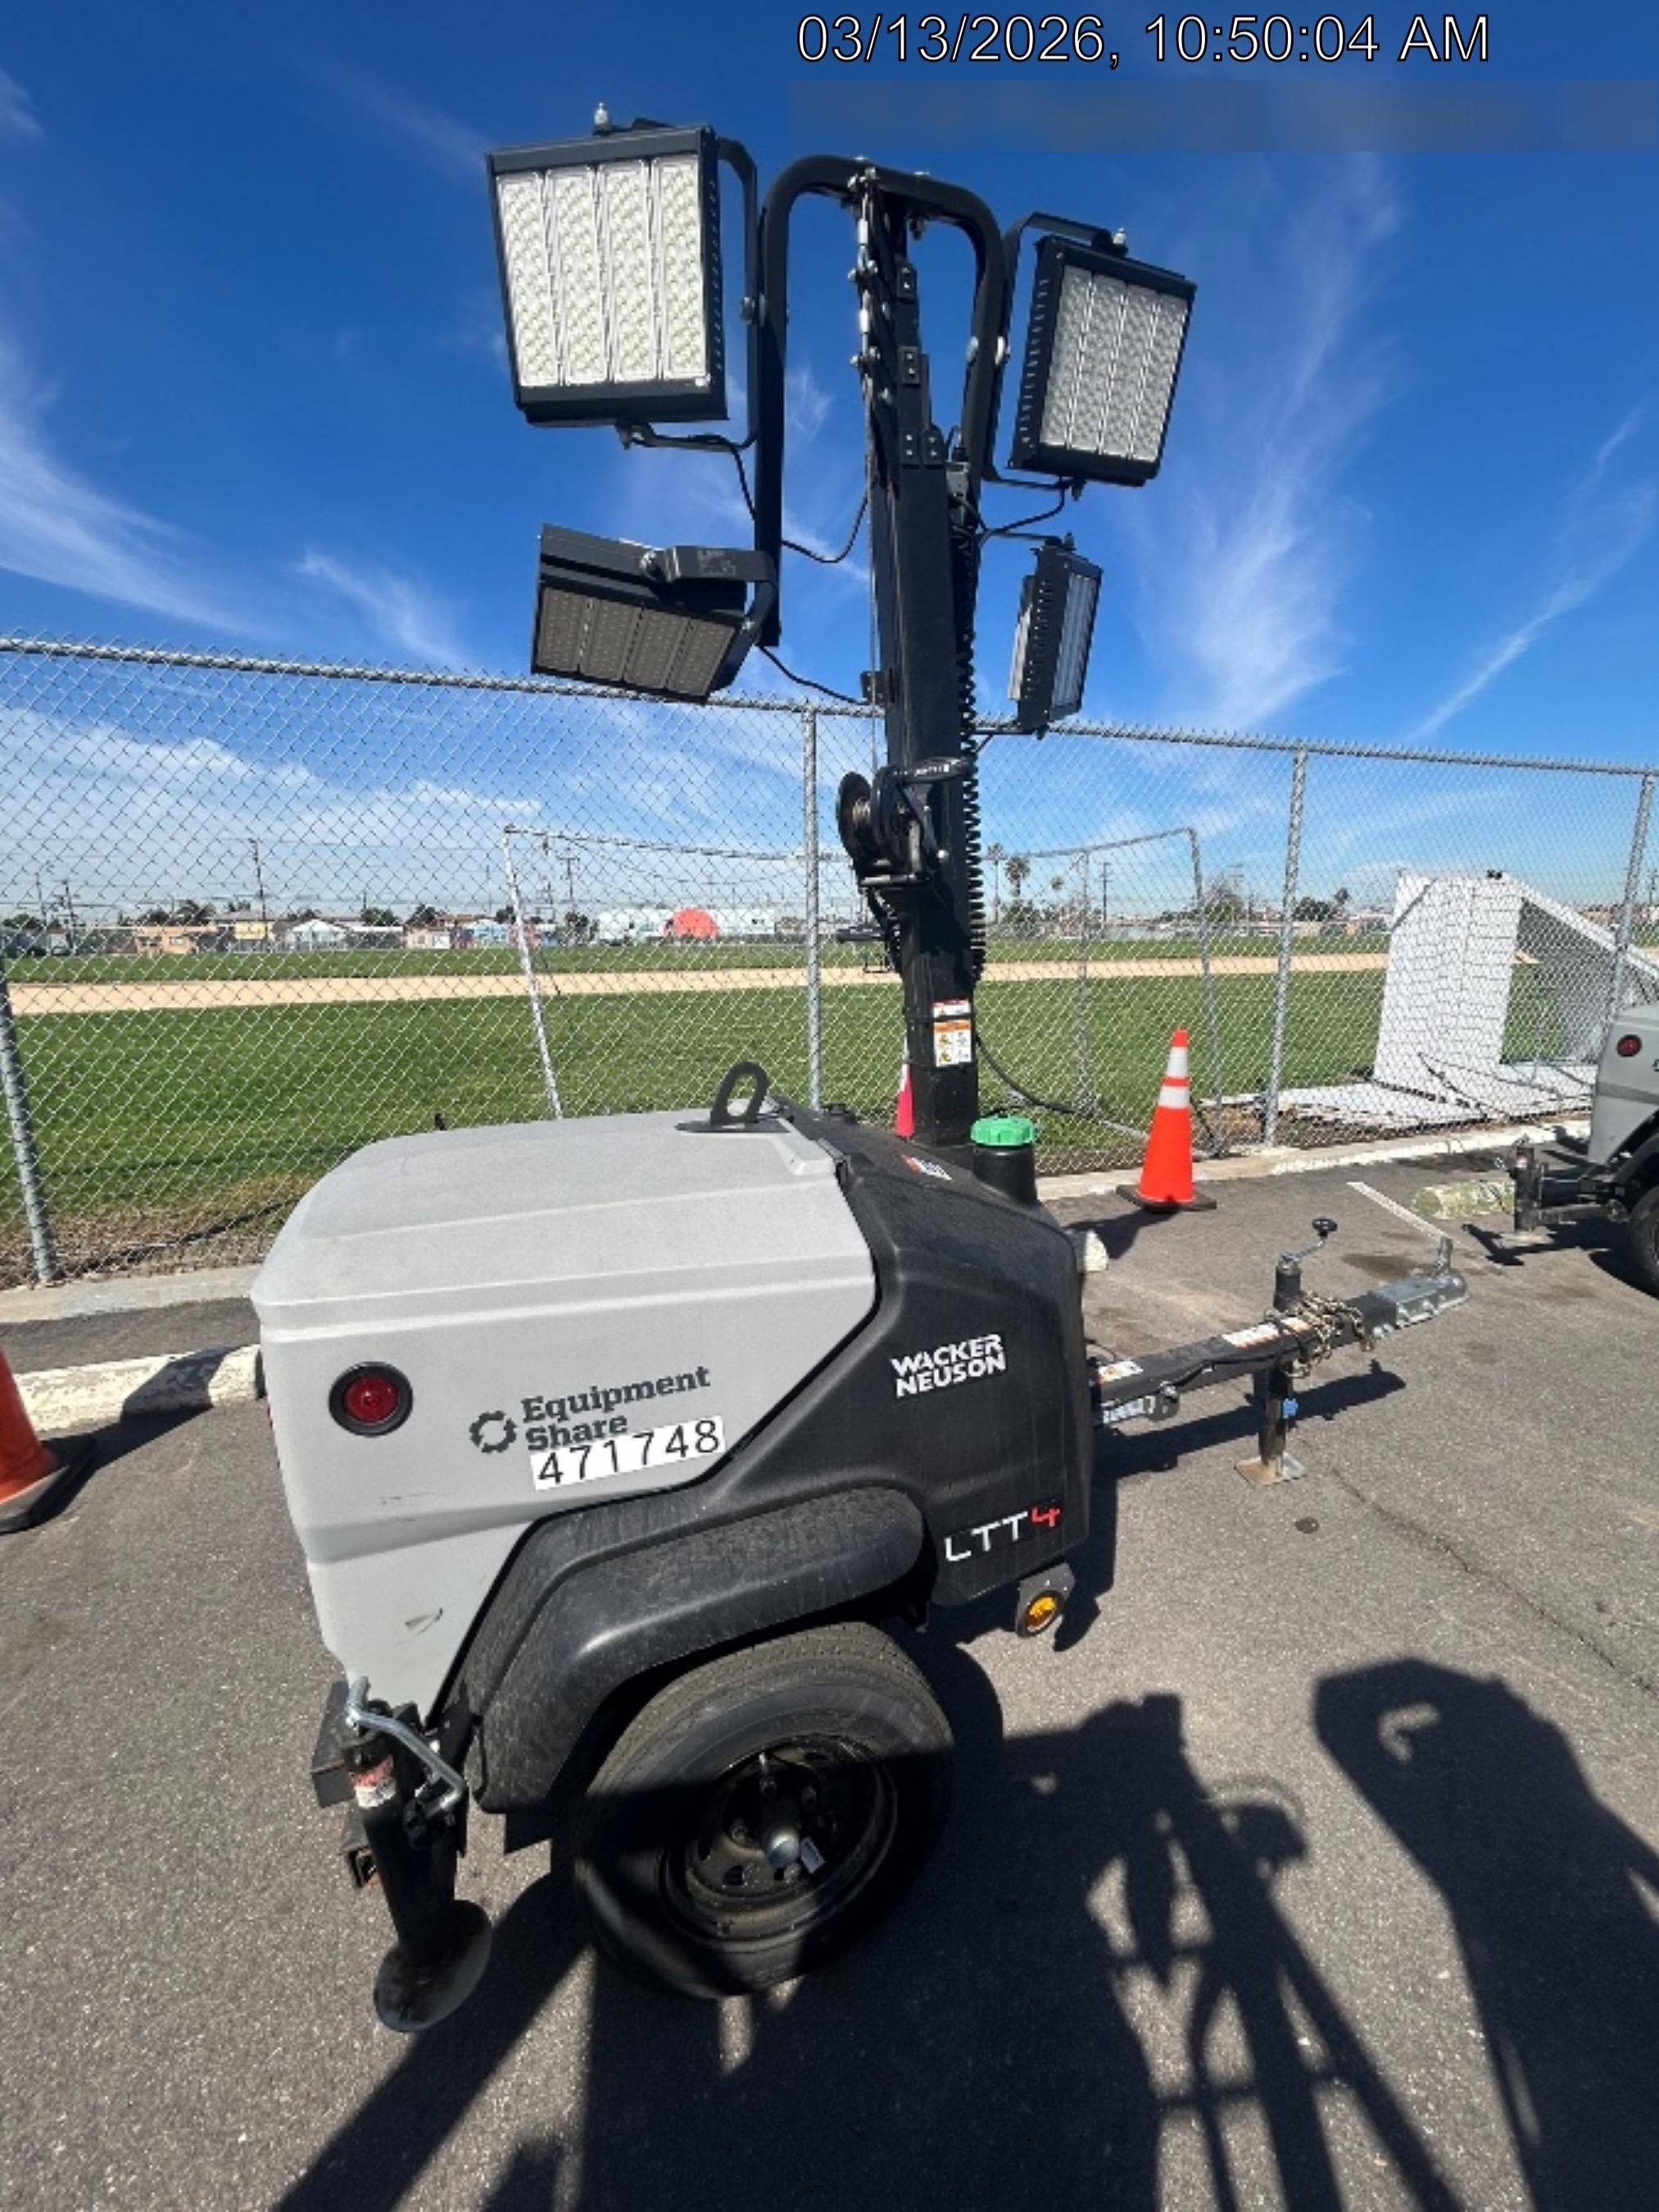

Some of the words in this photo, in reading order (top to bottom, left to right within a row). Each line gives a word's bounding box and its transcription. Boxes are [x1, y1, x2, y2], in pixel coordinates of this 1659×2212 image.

[891, 1333, 1004, 1377] WACKER
[895, 1353, 1007, 1398] NEUSON
[521, 1365, 711, 1424] Equipment
[525, 1415, 628, 1452] Share
[537, 1419, 721, 1485] 471748
